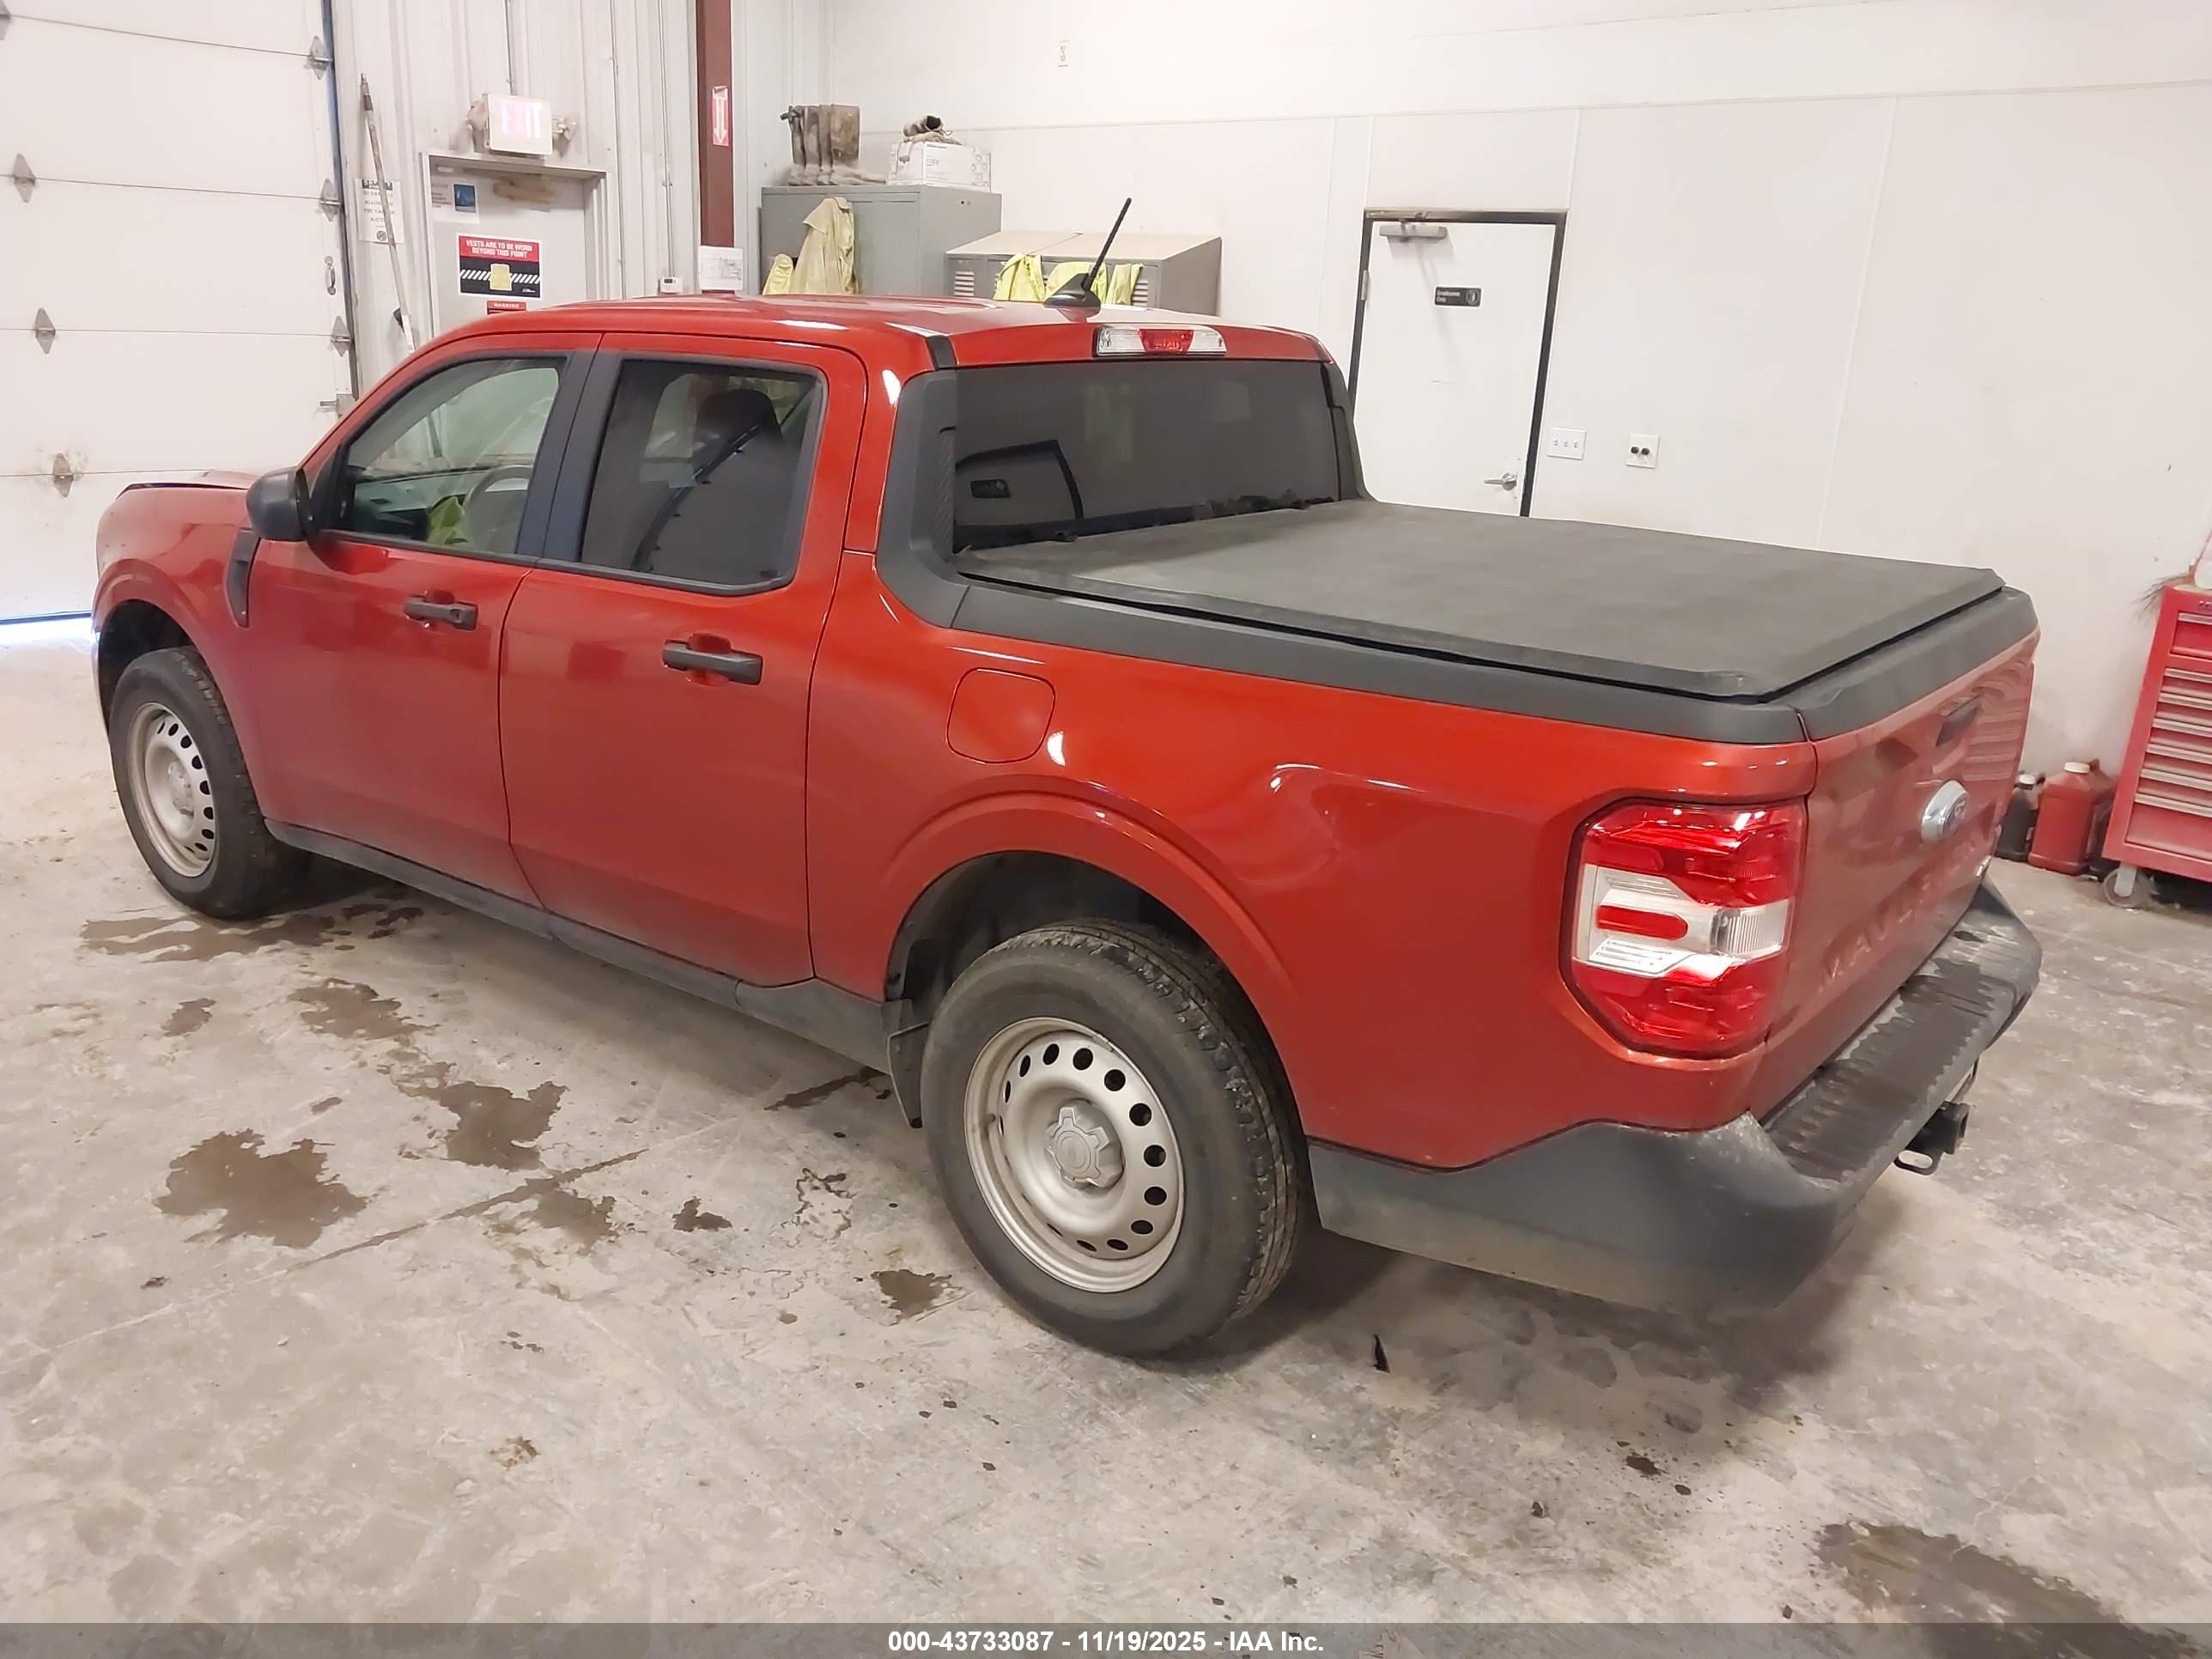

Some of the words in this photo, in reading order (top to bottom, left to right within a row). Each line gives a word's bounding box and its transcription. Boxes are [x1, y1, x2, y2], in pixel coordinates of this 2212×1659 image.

[501, 102, 543, 138] EXIT
[471, 246, 495, 255] BEYOND
[510, 250, 528, 258] POINT
[485, 240, 497, 249] ARE
[514, 243, 533, 252] WORN
